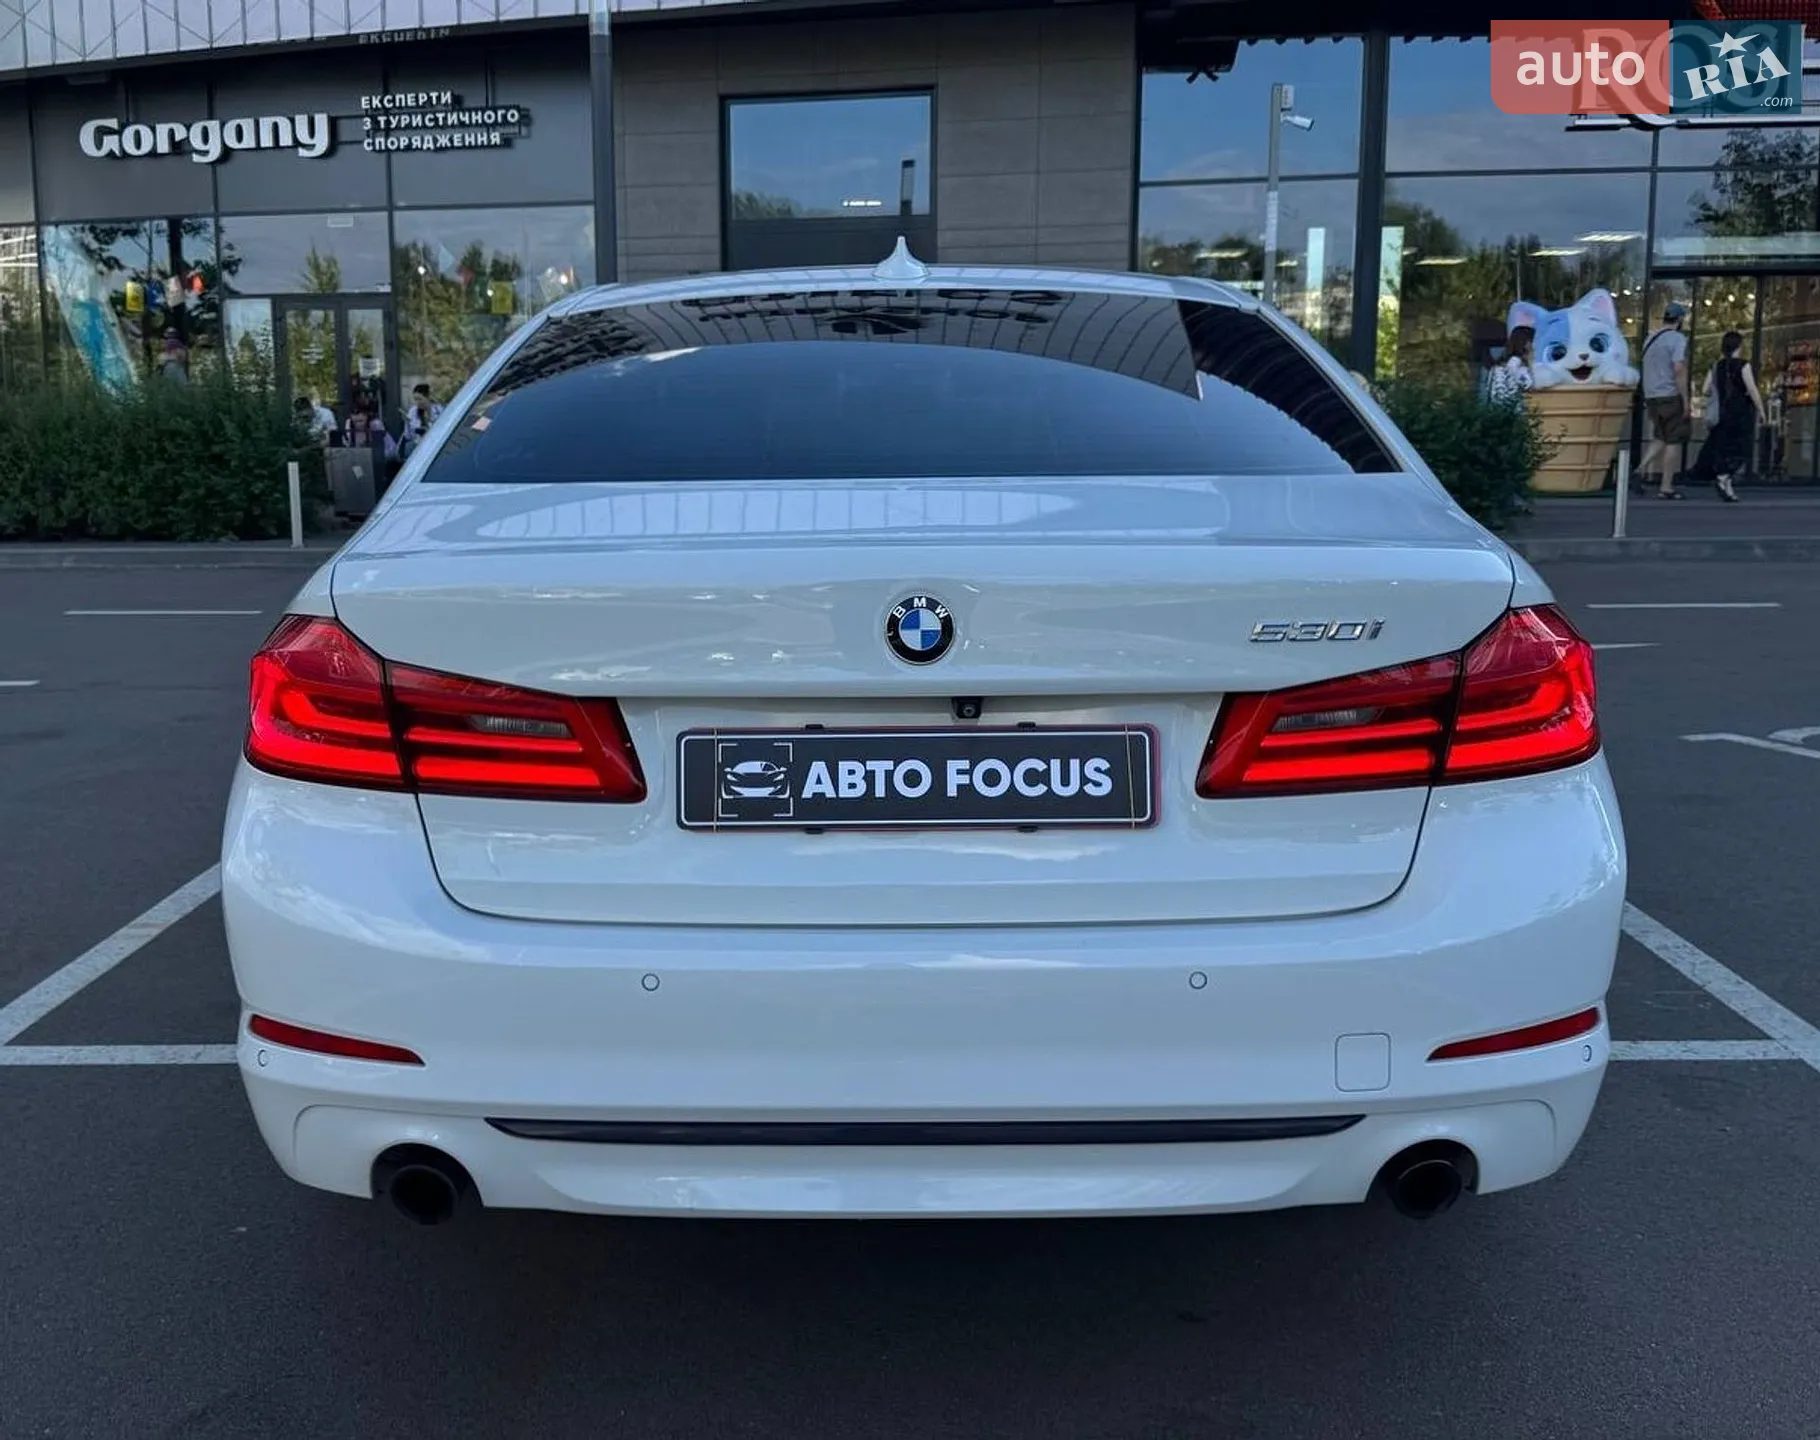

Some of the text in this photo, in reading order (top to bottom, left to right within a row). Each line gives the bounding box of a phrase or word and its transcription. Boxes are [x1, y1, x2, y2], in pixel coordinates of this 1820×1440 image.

[360, 90, 452, 109] ЕКСПЕРТИ
[377, 108, 520, 130] ТУРИСТИЧНОГО
[79, 112, 329, 163] Gorgany
[363, 132, 501, 151] СПОРЯДЖЕННЯ
[892, 596, 950, 619] BMW
[1249, 617, 1386, 643] 530i
[801, 758, 1113, 798] АВТО FOCUS
